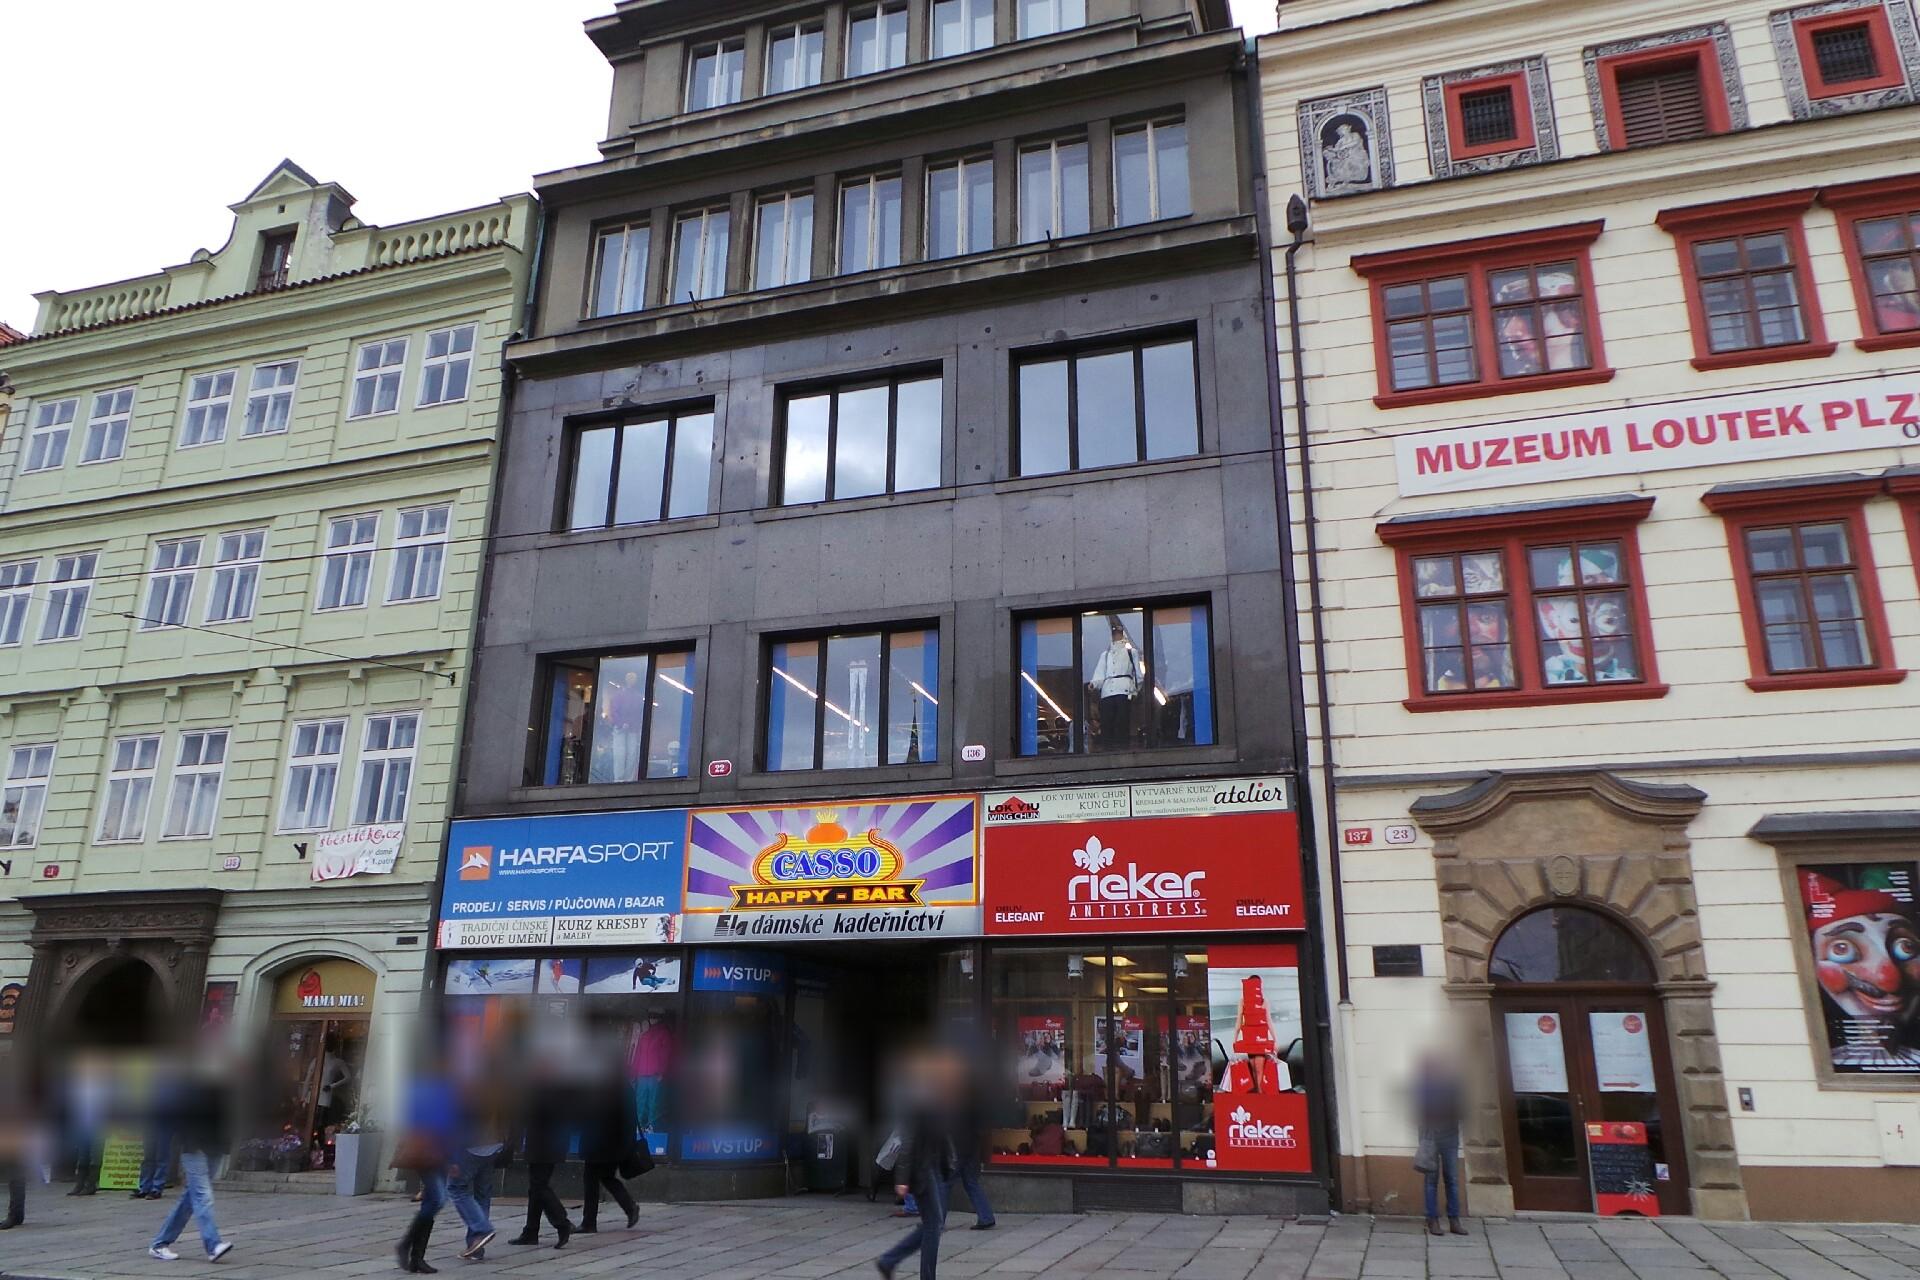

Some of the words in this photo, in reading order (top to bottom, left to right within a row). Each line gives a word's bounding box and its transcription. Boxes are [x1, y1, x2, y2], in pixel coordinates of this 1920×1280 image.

[1416, 426, 1612, 475] MUZEUM
[1625, 404, 1810, 452] LOUTEK
[1821, 393, 1920, 431] PLZ
[966, 748, 981, 758] 136
[1102, 790, 1126, 798] CHUN
[1187, 785, 1217, 793] KURZY
[1214, 782, 1282, 804] atelier
[988, 804, 1012, 813] LOK
[1019, 802, 1040, 811] YIU
[1080, 800, 1109, 810] KUNG
[1113, 799, 1126, 808] FU
[989, 813, 1012, 821] WING
[1014, 811, 1040, 820] CHUN
[1347, 830, 1369, 842] 137
[1393, 829, 1409, 840] 23
[499, 841, 674, 867] HARFASPORT
[772, 847, 879, 880] CASSO
[1068, 862, 1206, 901] rieker
[746, 889, 829, 905] HAPPY
[853, 887, 906, 902] BAR
[452, 902, 496, 914] PRODEJ
[507, 899, 547, 912] SERVIS
[625, 896, 664, 908] BAZAR
[1070, 901, 1201, 918] ANTISTRESS
[1236, 905, 1291, 916] ELEGANT
[752, 913, 824, 934] dámské
[833, 910, 945, 934] kadeřnictví
[995, 911, 1045, 922] ELEGANT
[557, 919, 592, 930] KURZ
[597, 918, 648, 930] KRESBY
[508, 929, 549, 944] UMĚNÍ
[563, 931, 592, 940] MALBY
[722, 966, 772, 981] VSTUP
[303, 995, 335, 1007] MAMA
[1229, 1119, 1294, 1139] rieker
[712, 1138, 763, 1154] VSTUP
